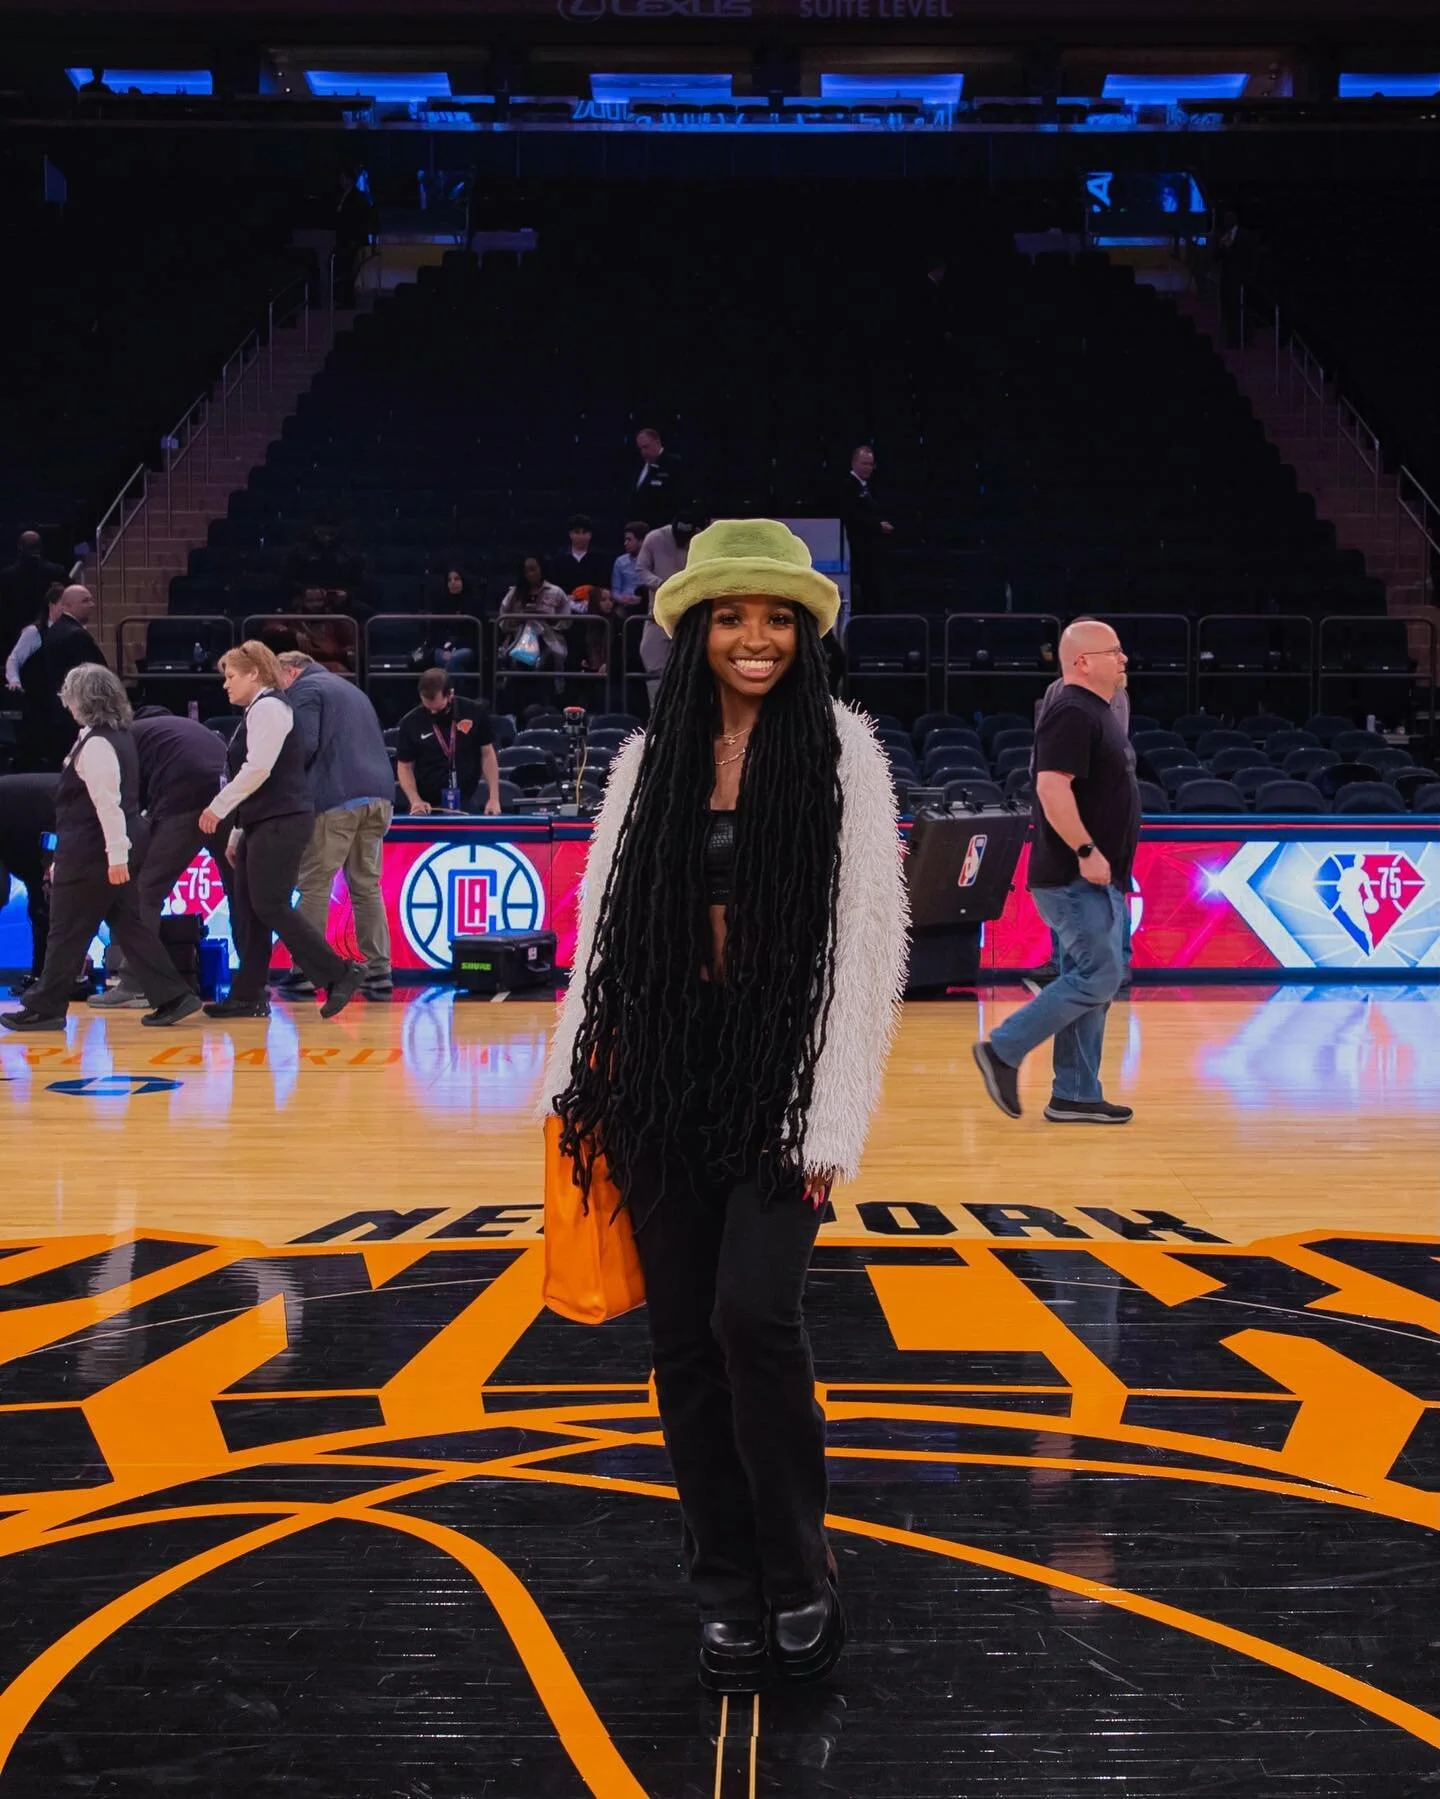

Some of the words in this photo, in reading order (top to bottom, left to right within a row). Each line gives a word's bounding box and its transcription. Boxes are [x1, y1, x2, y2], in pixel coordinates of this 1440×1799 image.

[611, 0, 752, 17] LEXUS
[801, 0, 870, 19] SUITE
[879, 0, 954, 19] LEVEL
[187, 867, 210, 900] 75
[1377, 866, 1402, 899] 75
[284, 1204, 545, 1244] NE
[820, 1201, 1232, 1244] ORK
